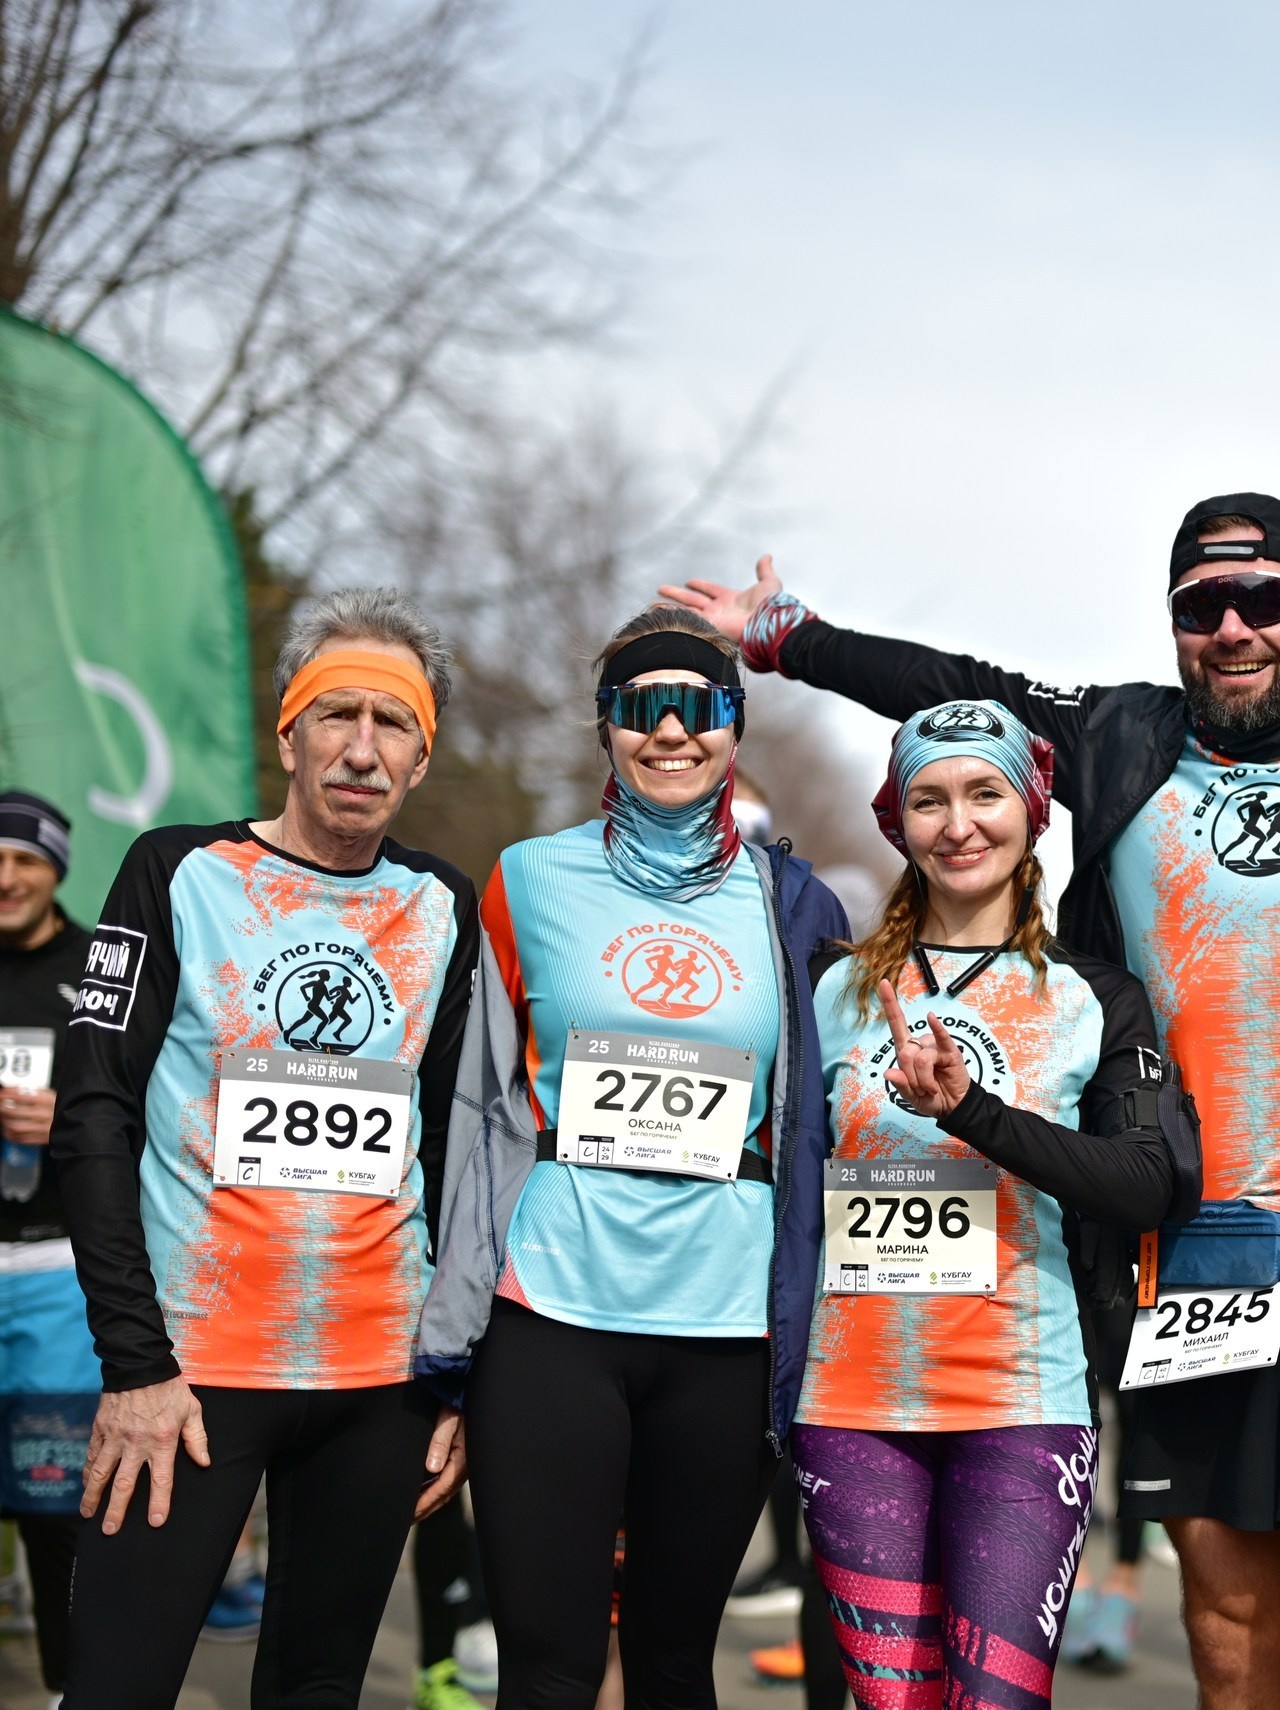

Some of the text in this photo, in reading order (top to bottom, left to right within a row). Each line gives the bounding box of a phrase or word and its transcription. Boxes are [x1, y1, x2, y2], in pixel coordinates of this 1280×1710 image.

[1218, 576, 1234, 584] poc
[1193, 782, 1217, 819] БЕГ
[1220, 769, 1247, 786] ПО
[600, 923, 744, 982] БЕГ ПО ГОРЯЧЕМУ
[253, 942, 395, 1013] БЕГ ПО ГОРЯЧЕМУ
[588, 1040, 610, 1054] 25
[627, 1044, 667, 1060] HARD
[669, 1048, 699, 1064] RUN
[937, 1016, 1006, 1076] ОРЯЧЕМУ
[246, 1058, 268, 1072] 25
[287, 1062, 326, 1077] HARD
[328, 1065, 358, 1081] RUN
[594, 1069, 728, 1120] 2767
[243, 1097, 392, 1154] 2892
[628, 1118, 682, 1132] ОКСАНА
[637, 1146, 672, 1155] ВЫСШАЯ
[693, 1152, 721, 1163] КУБГАУ
[348, 1171, 376, 1180] КУБГАУ
[841, 1168, 935, 1182] 25 HARD RUN
[847, 1196, 970, 1239] 2796
[876, 1245, 929, 1254] МАРИНА
[1155, 1288, 1274, 1340] 2845
[1182, 1332, 1229, 1347] МИХАИЛ
[1188, 1356, 1217, 1365] ВЫСШАЯ
[1233, 1349, 1260, 1358] КУБГАУ
